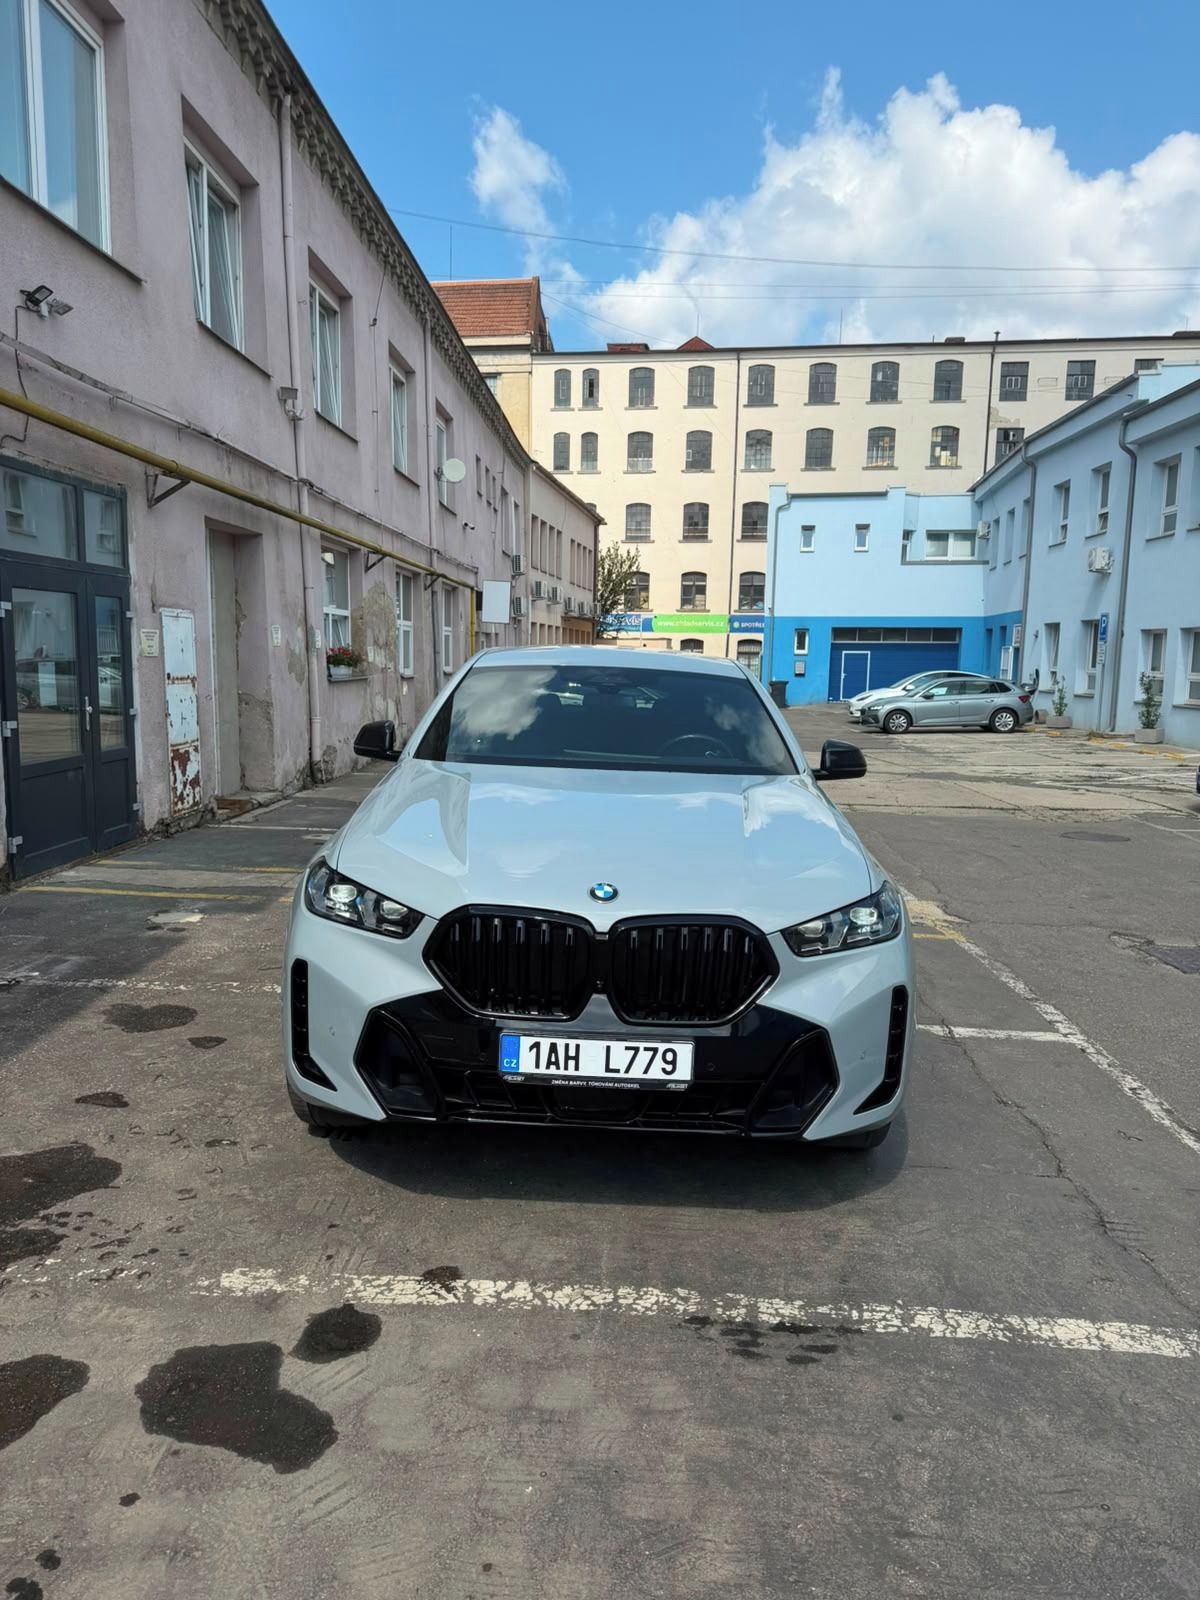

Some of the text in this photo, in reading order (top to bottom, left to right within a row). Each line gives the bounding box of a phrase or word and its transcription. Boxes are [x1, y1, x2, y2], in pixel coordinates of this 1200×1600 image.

[503, 1058, 517, 1068] CZ
[528, 1041, 678, 1076] 1AH L779
